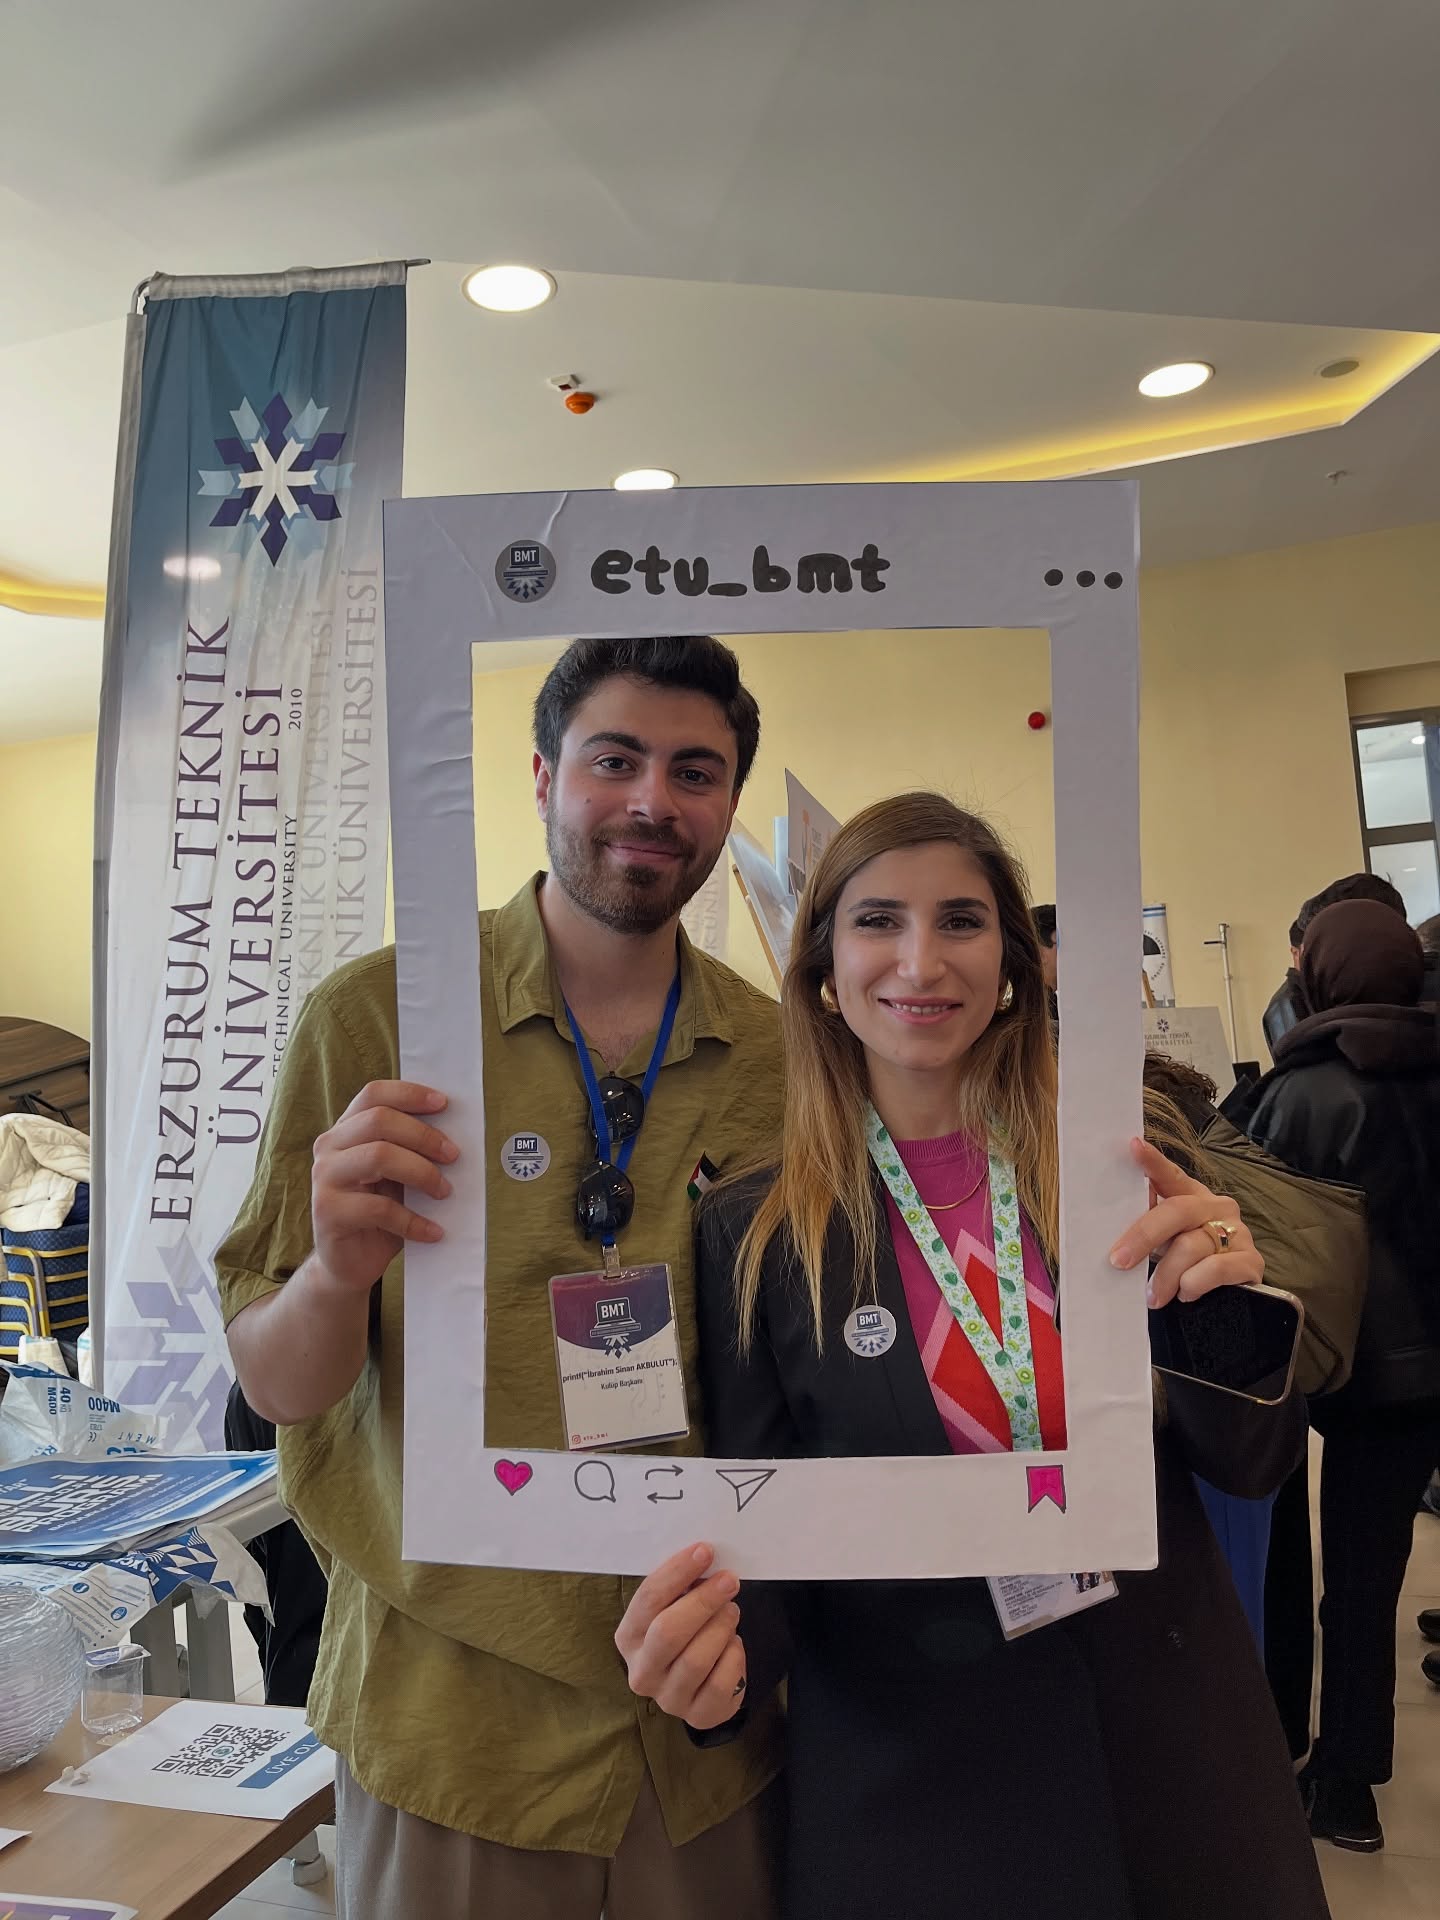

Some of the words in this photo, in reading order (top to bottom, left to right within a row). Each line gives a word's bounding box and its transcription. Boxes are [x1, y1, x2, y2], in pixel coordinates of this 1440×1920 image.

[514, 549, 537, 563] BMT
[590, 543, 891, 597] etu_bmt
[288, 688, 303, 730] 2010
[332, 567, 378, 863] ÜNİVERSİTESİ
[173, 616, 230, 870] TEKNİK
[280, 814, 298, 939] UNIVERSITY
[207, 684, 283, 1148] ÜNİVERSİTESİ
[330, 876, 367, 958] NİK
[150, 896, 213, 1224] ERZURUM
[517, 1139, 536, 1150] BMT
[601, 1302, 626, 1319] BMT
[859, 1313, 879, 1326] BMT
[615, 1365, 635, 1374] Sinan
[47, 1386, 57, 1415] M400
[60, 1386, 71, 1403] 40
[88, 1396, 121, 1413] M400
[117, 1431, 157, 1445] MENT
[264, 1755, 300, 1774] ÜYE
[294, 1742, 320, 1755] OL
